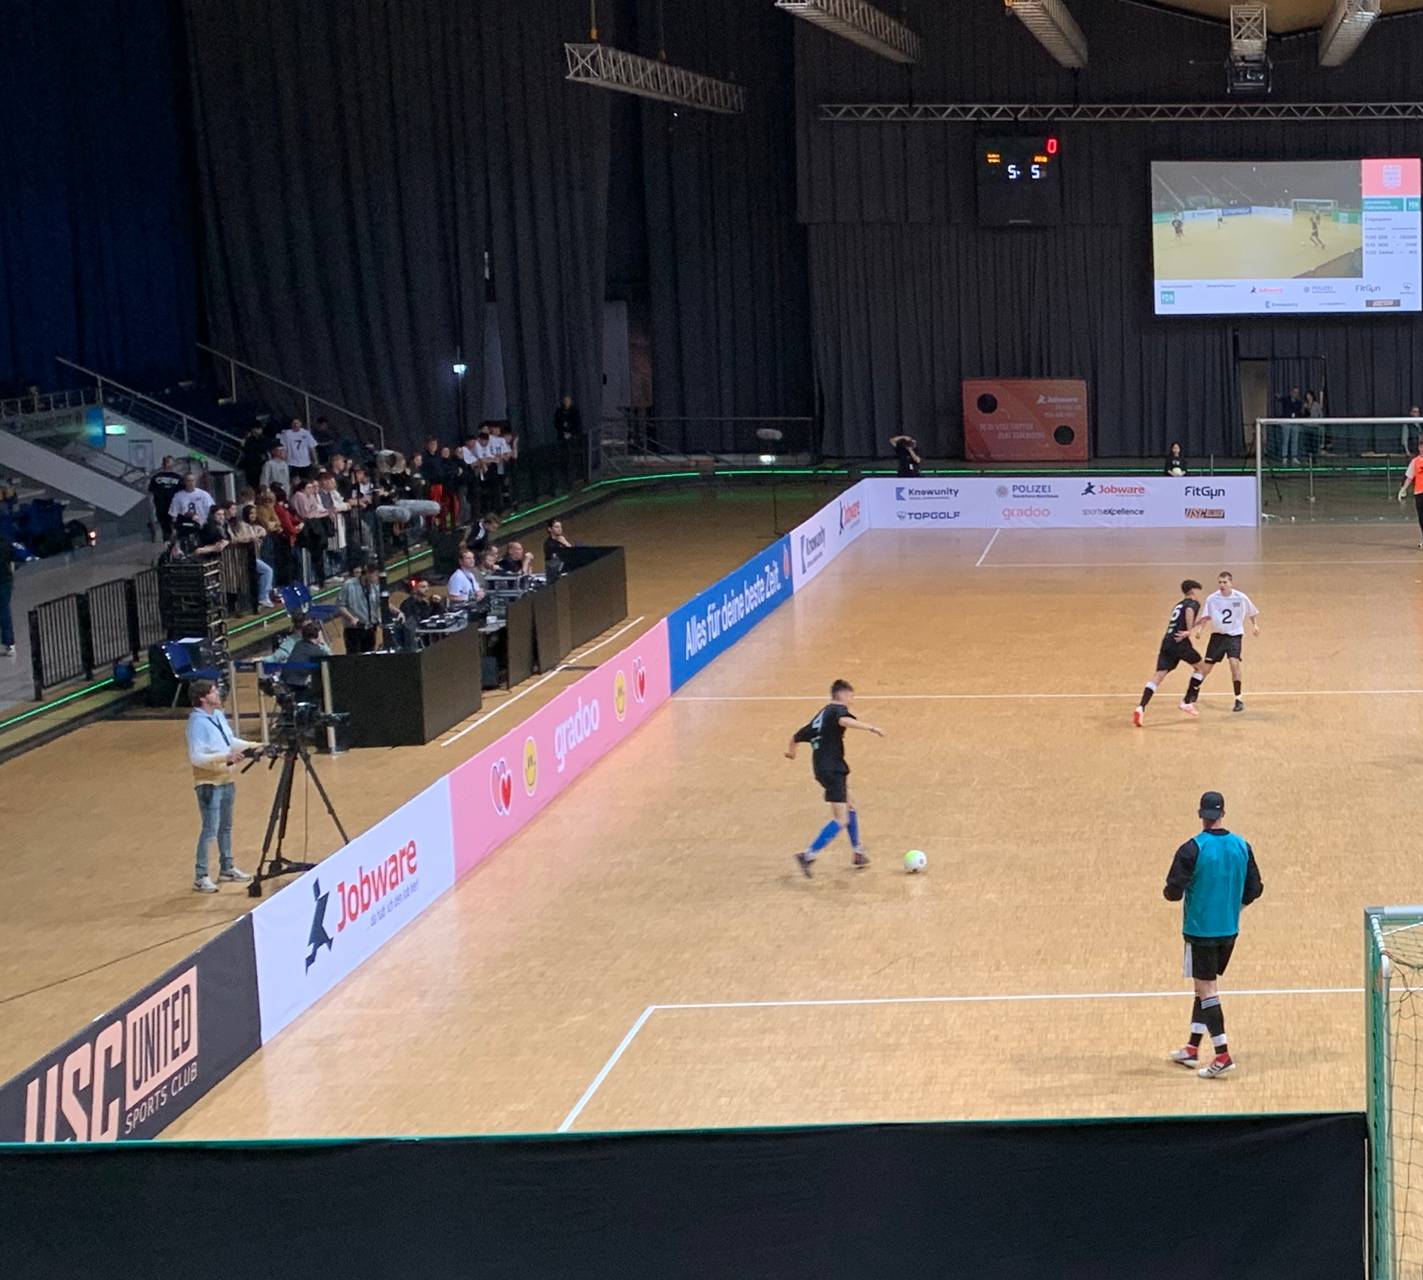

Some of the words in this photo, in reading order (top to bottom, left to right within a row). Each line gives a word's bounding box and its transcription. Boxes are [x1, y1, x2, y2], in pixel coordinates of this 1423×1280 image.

[1007, 164, 1017, 179] 5
[1031, 164, 1041, 179] 5
[908, 487, 959, 497] Knowunity
[1012, 485, 1051, 493] POLIZEI
[1098, 485, 1145, 494] Jobware
[907, 511, 960, 520] TOPGOLF
[1002, 506, 1050, 520] gradoo
[685, 614, 707, 661] Alles
[707, 602, 721, 642] für
[721, 589, 744, 632] deine
[743, 574, 765, 616] beste
[1222, 608, 1233, 624] 2
[555, 697, 599, 773] gradoo
[336, 839, 417, 932] Jobware
[131, 983, 192, 1093] UNITED
[24, 1020, 124, 1143] USC
[124, 1089, 168, 1136] SPORTS
[170, 1061, 199, 1098] CLUB
